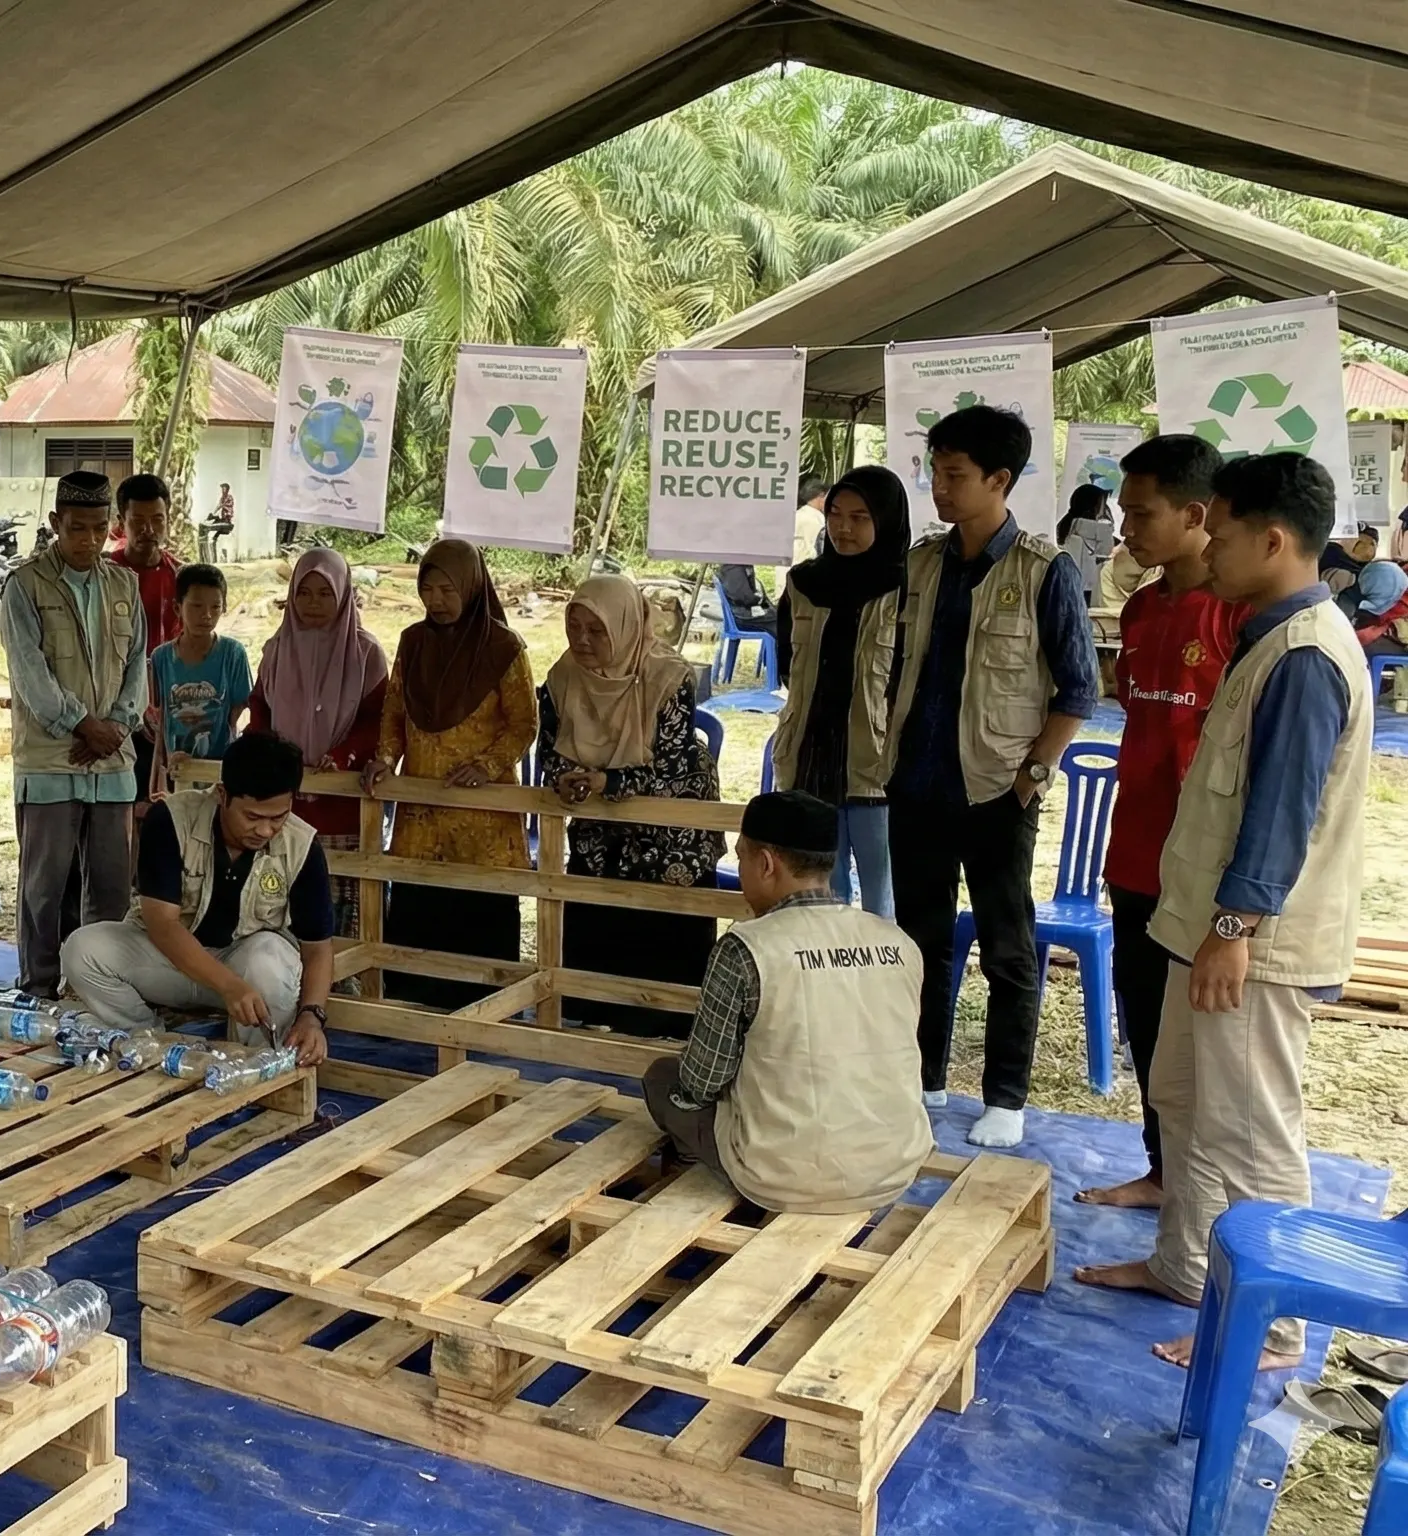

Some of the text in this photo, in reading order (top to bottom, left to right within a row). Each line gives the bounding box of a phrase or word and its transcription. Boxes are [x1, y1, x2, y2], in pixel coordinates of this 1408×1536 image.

[663, 409, 791, 440] REDUCE,
[661, 439, 789, 476] REUSE,
[659, 475, 786, 499] RECYCLE
[794, 946, 905, 970] TIM MBKM USK
